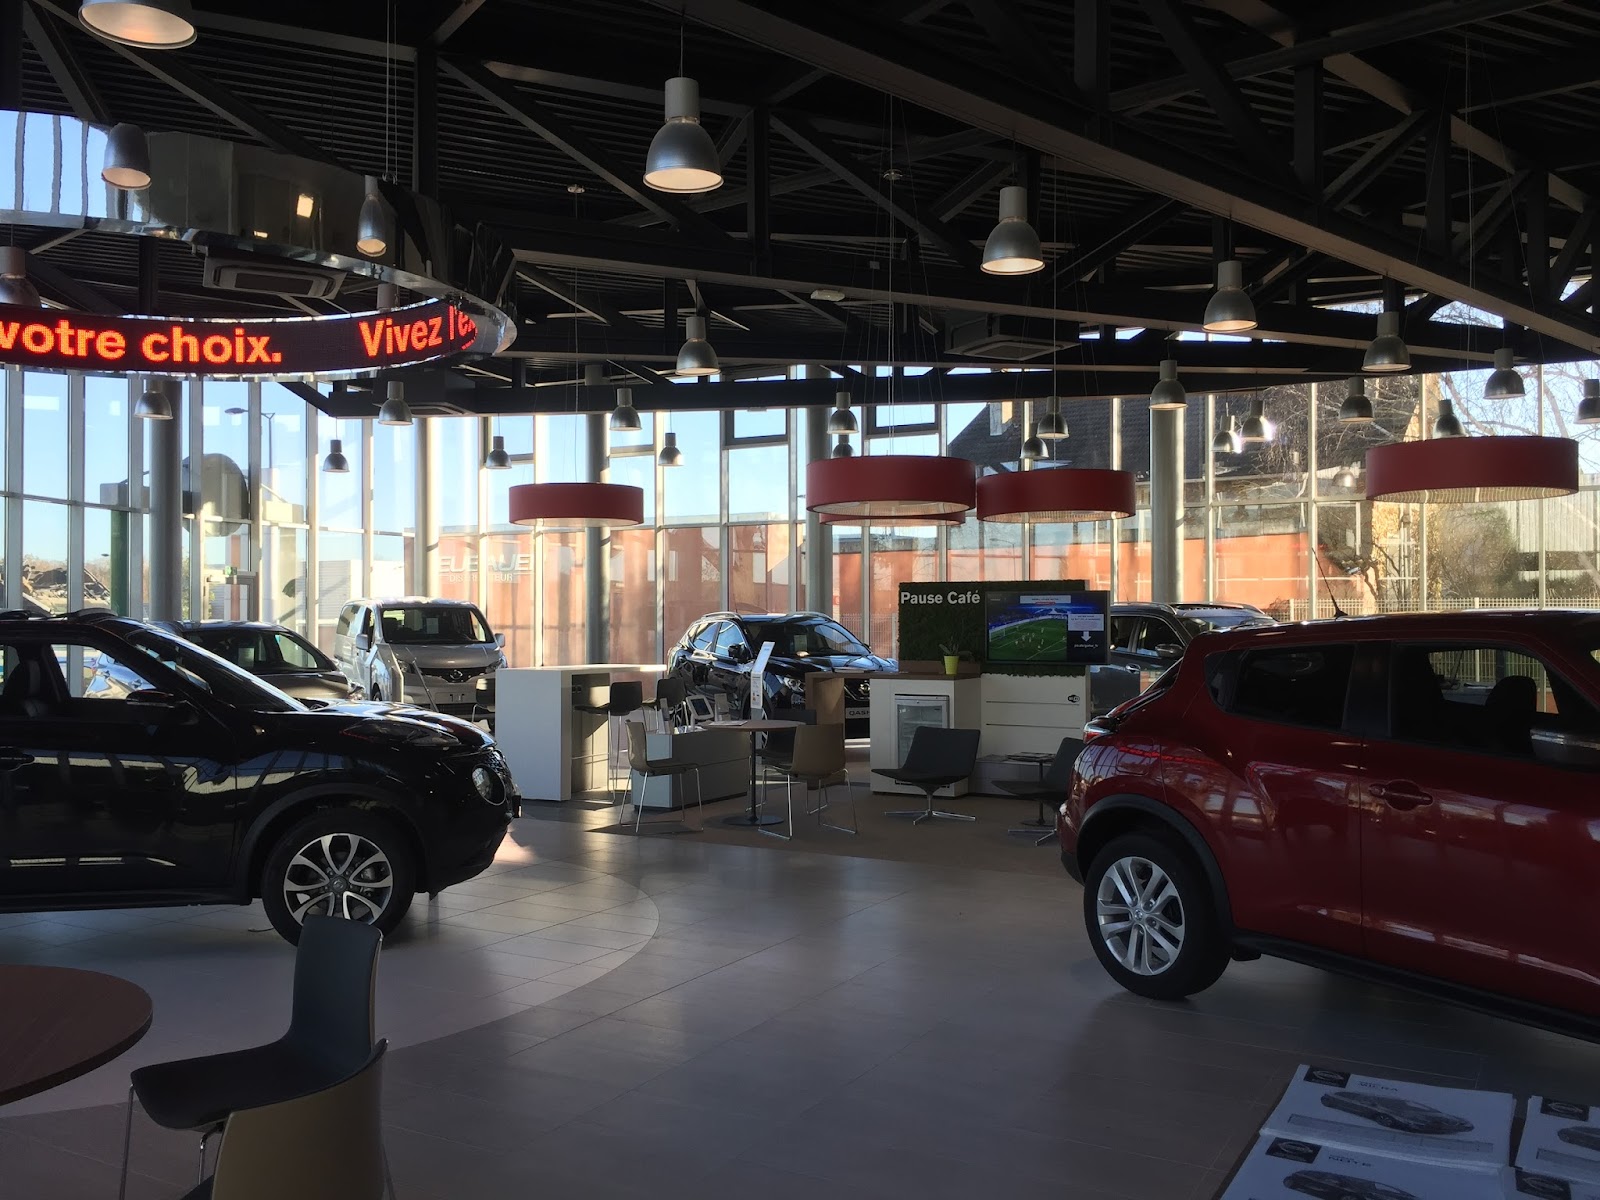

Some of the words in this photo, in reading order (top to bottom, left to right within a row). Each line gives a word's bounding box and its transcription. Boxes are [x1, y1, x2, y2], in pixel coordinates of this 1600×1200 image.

[141, 327, 282, 364] choix.
[358, 317, 442, 356] Vivez
[900, 592, 943, 604] Pause
[947, 589, 981, 605] Café
